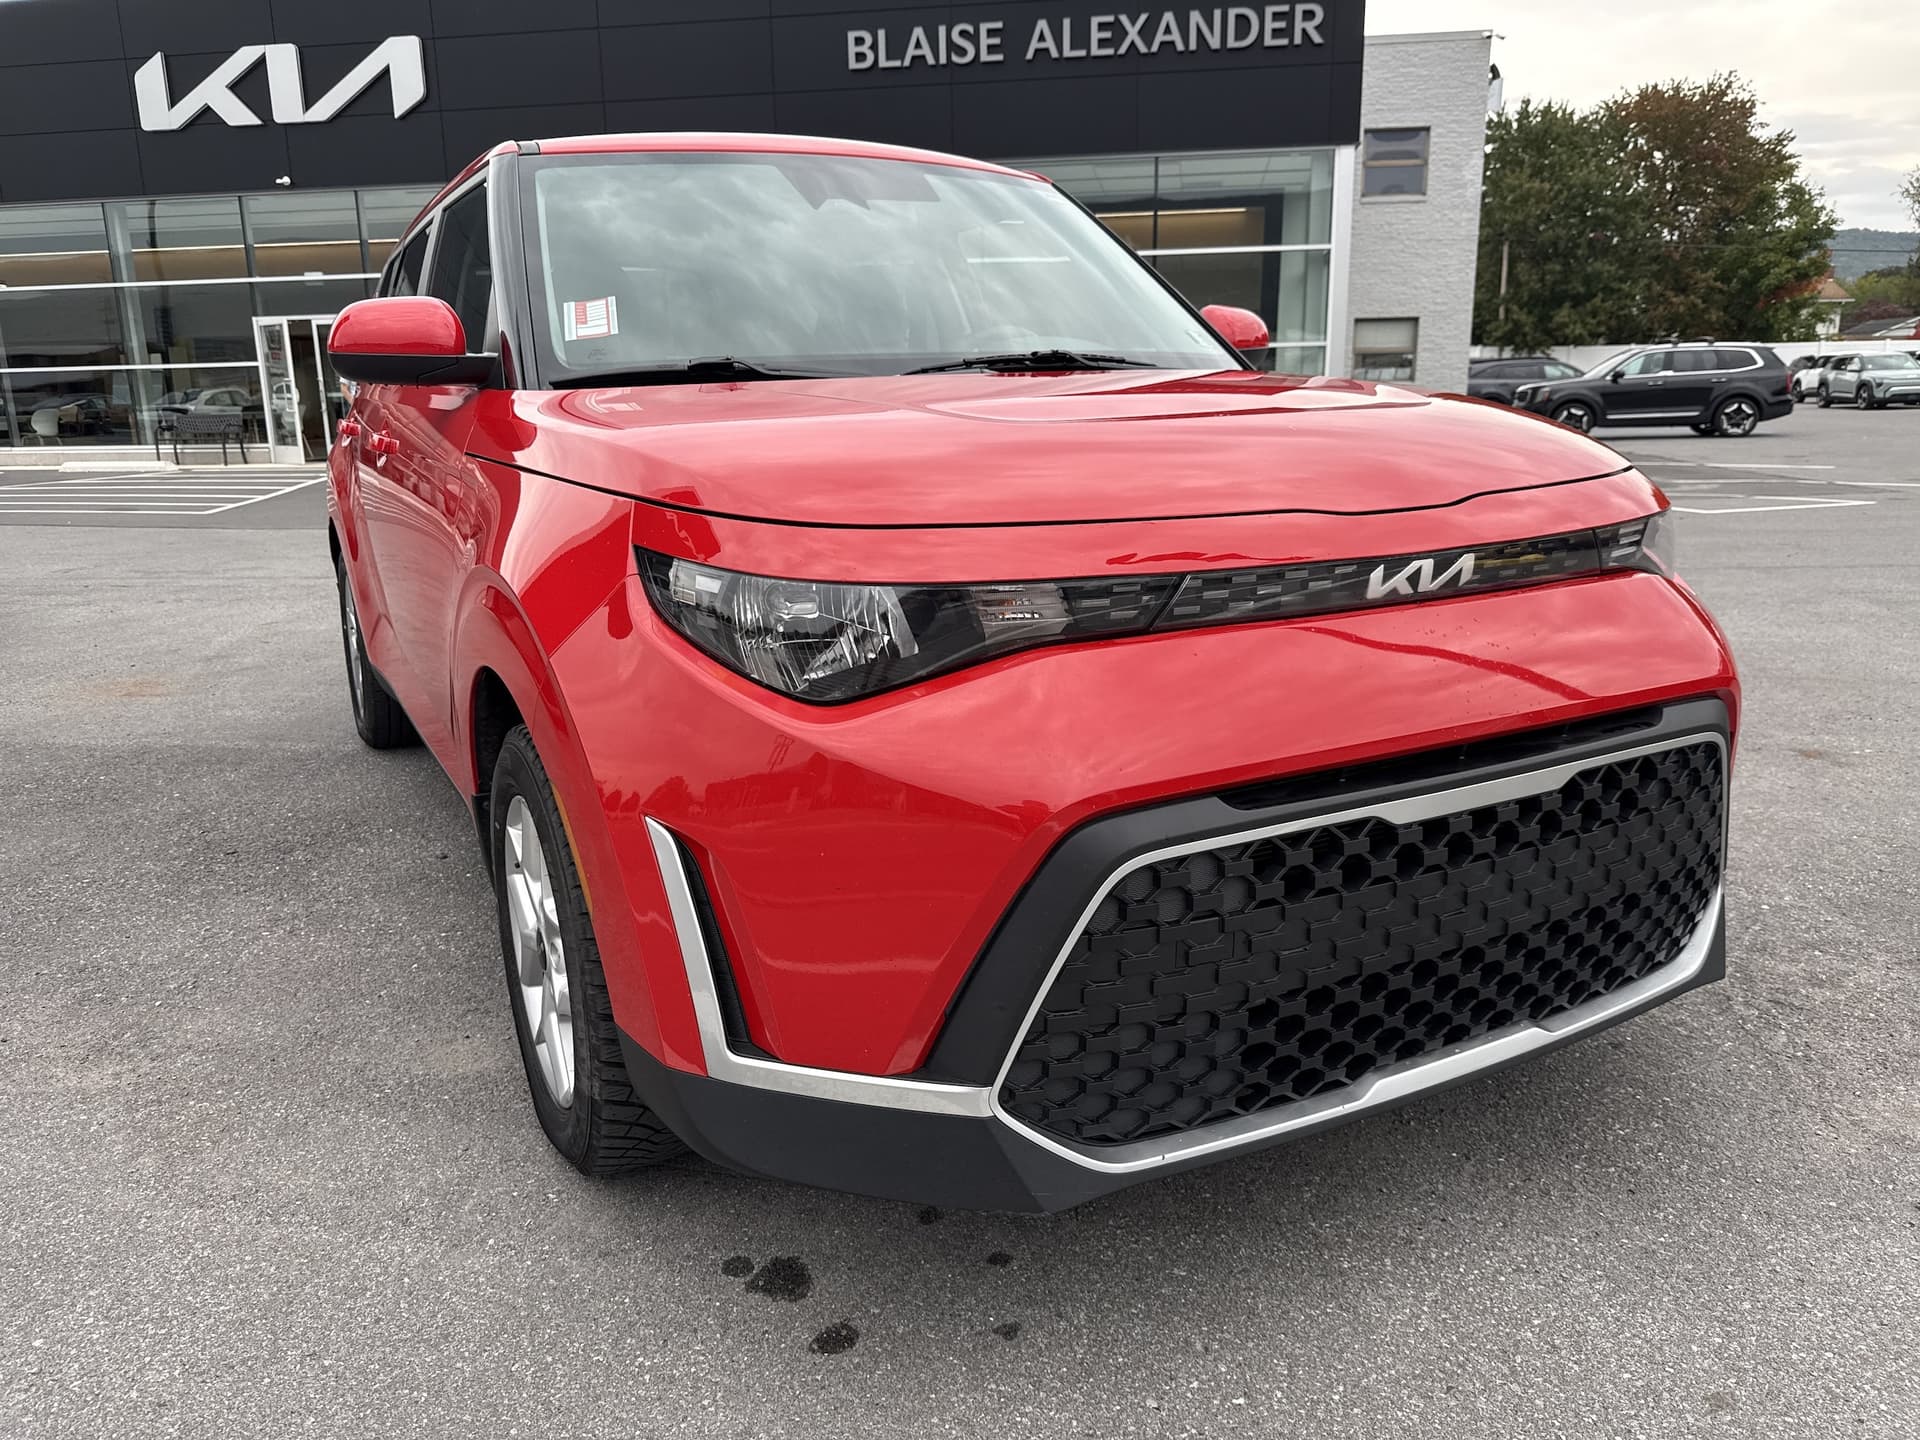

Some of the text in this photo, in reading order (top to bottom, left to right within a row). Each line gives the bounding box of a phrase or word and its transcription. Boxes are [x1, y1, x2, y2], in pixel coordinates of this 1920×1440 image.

[846, 3, 1325, 71] BLAISE ALEXANDER
[134, 34, 427, 132] KIA
[1366, 553, 1476, 599] KIA
